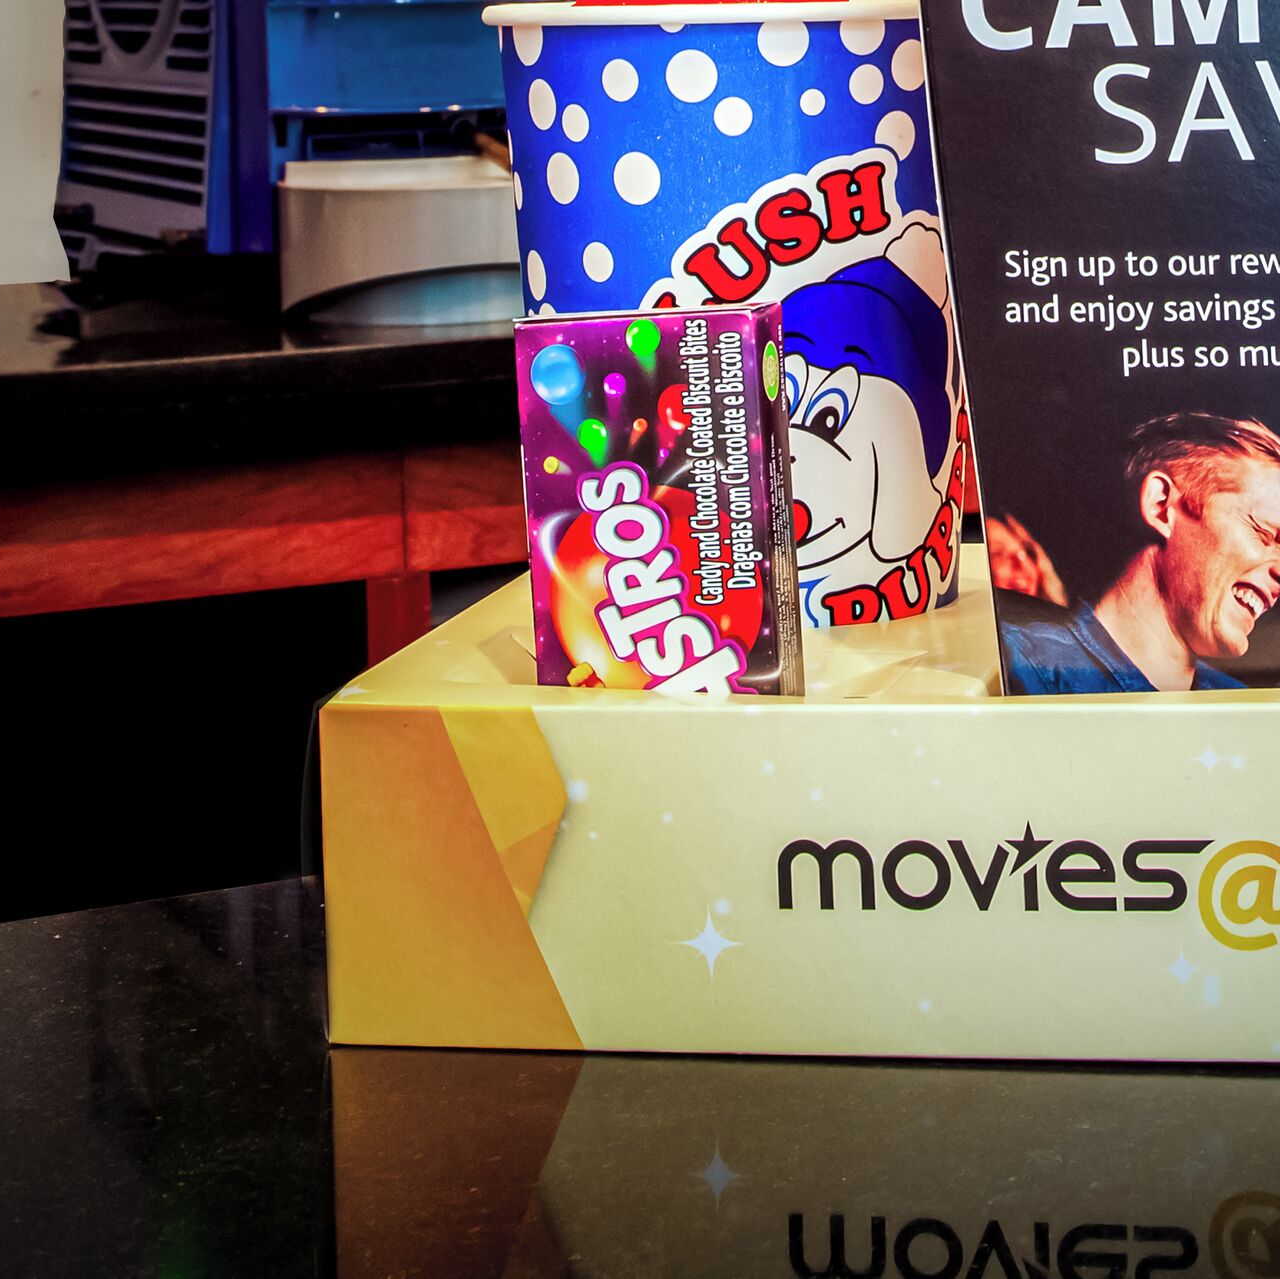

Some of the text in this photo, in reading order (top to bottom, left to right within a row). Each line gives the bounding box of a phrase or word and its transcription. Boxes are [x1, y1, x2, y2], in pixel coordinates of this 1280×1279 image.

[654, 161, 890, 311] USH
[1004, 250, 1068, 285] Sign
[1078, 257, 1115, 285] up
[1125, 251, 1158, 276] to
[1167, 252, 1220, 276] our
[1004, 294, 1059, 323] and
[1069, 294, 1154, 331] enjoy
[1163, 293, 1276, 328] savings
[1122, 339, 1185, 376] plus
[1195, 346, 1228, 368] so
[678, 318, 730, 605] Candy and Chocolate Coated Biscuit Bites
[712, 331, 763, 589] Drageias com Chocolate e Biscoito
[580, 467, 739, 694] ASTROS
